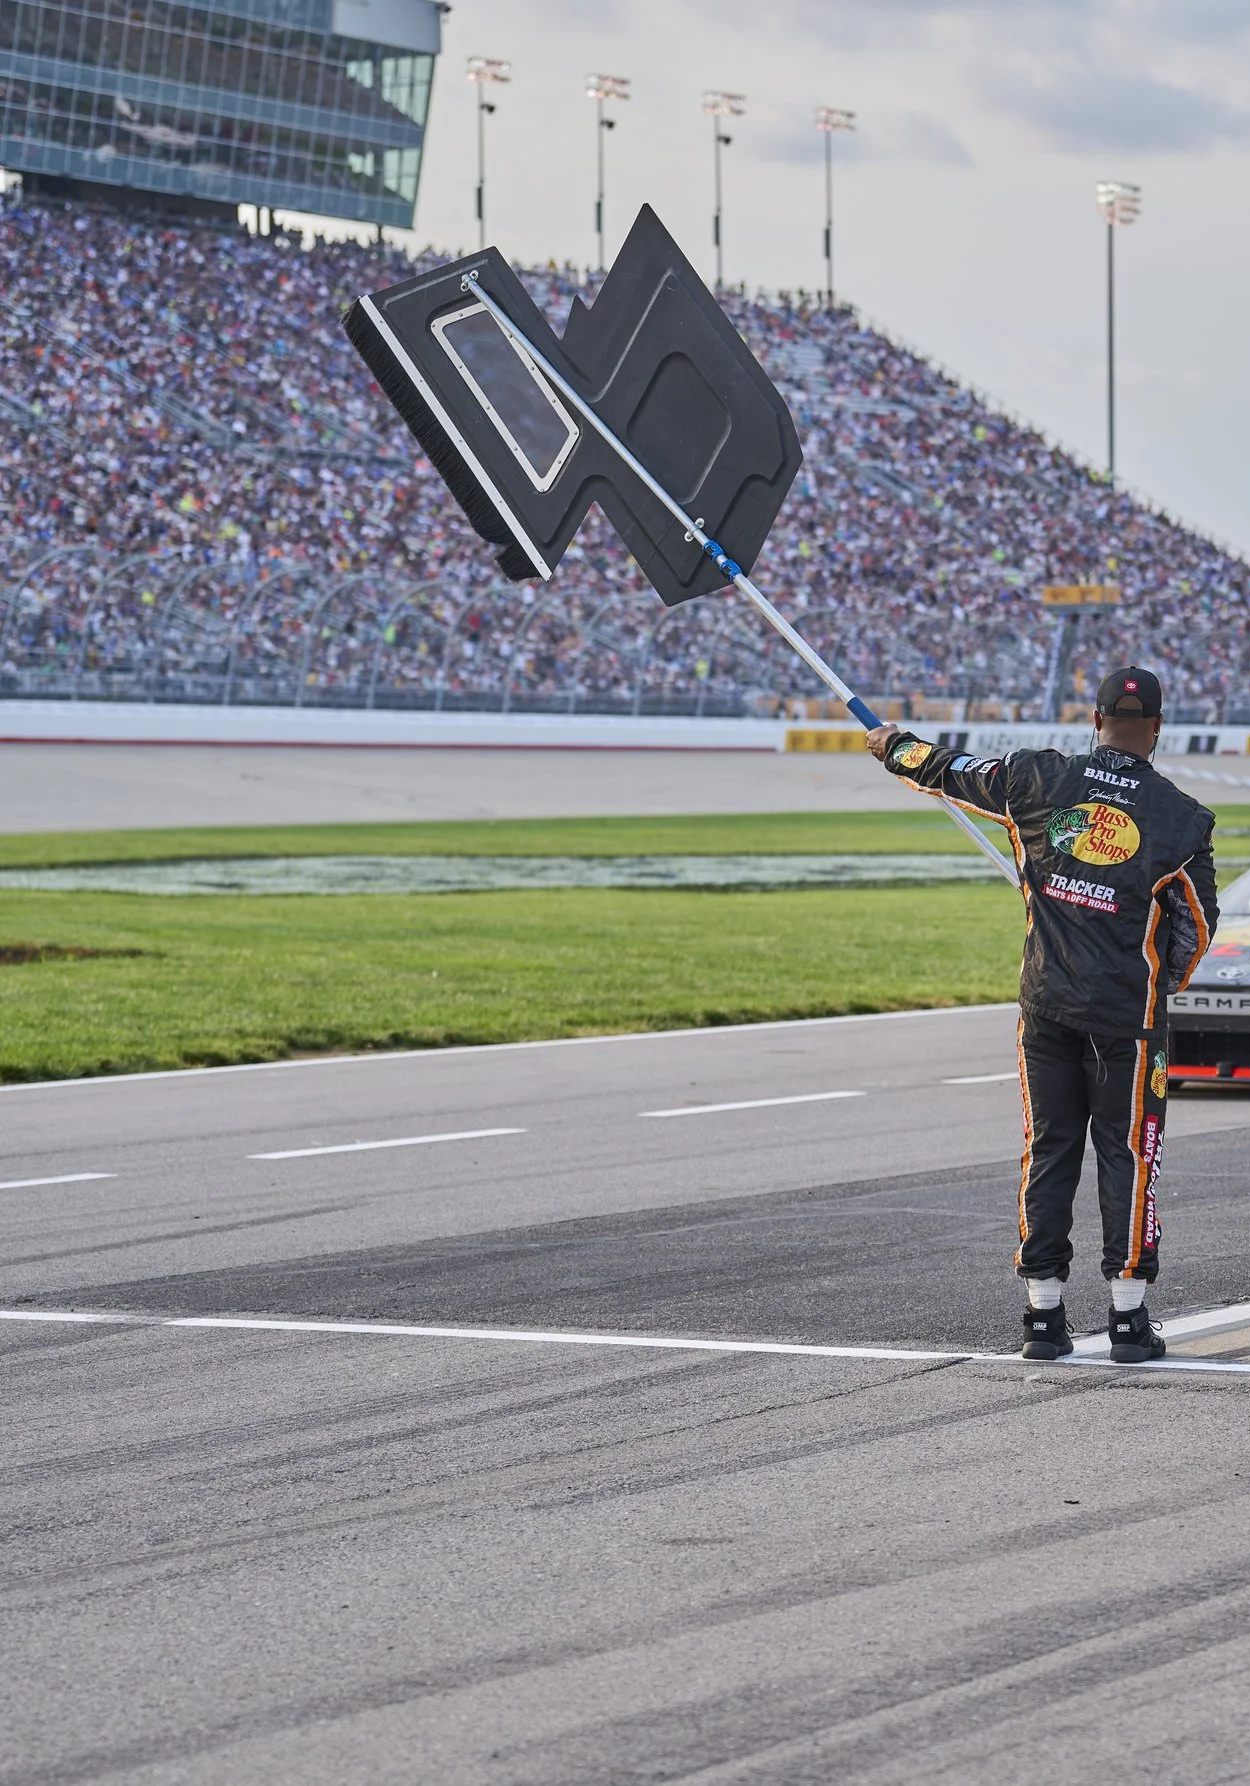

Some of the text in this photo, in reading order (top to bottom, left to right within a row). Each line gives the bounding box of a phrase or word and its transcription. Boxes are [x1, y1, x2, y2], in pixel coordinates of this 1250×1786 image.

[1083, 767, 1140, 789] BAILEY
[1091, 804, 1130, 828] Bass
[1089, 821, 1116, 840] Pro
[1085, 836, 1131, 861] Shops
[1045, 886, 1066, 899] BOATS
[1070, 893, 1088, 905] OFF
[1144, 1121, 1157, 1163] BOATS
